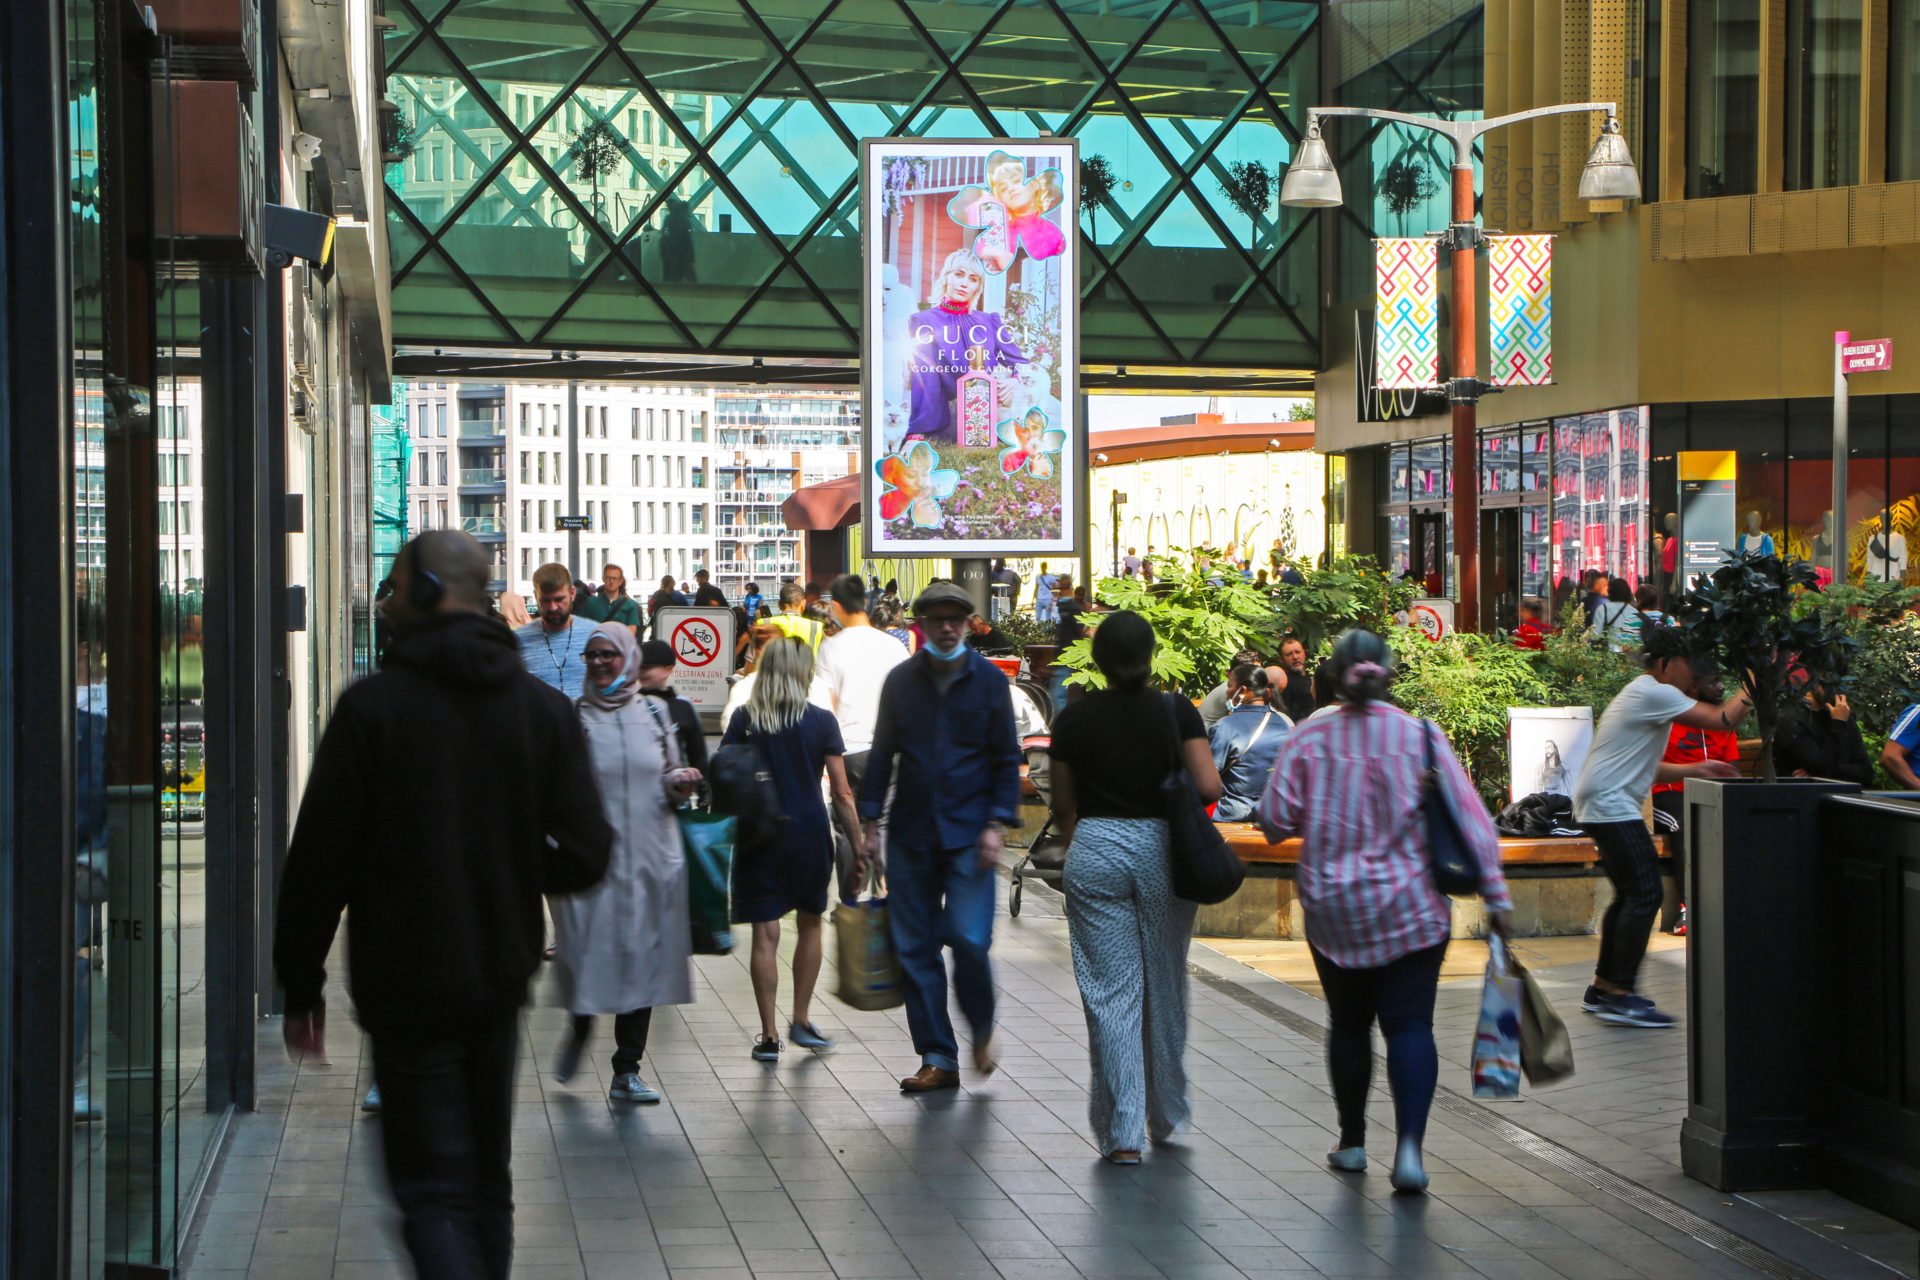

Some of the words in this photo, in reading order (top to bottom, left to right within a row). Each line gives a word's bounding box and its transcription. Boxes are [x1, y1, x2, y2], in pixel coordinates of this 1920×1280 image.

[1541, 152, 1560, 222] HOME
[1516, 167, 1533, 230] FOOD
[915, 324, 1029, 344] GUCCI
[938, 349, 1006, 361] FLORA
[911, 365, 972, 373] GORGEOUS
[707, 670, 723, 678] ZONE
